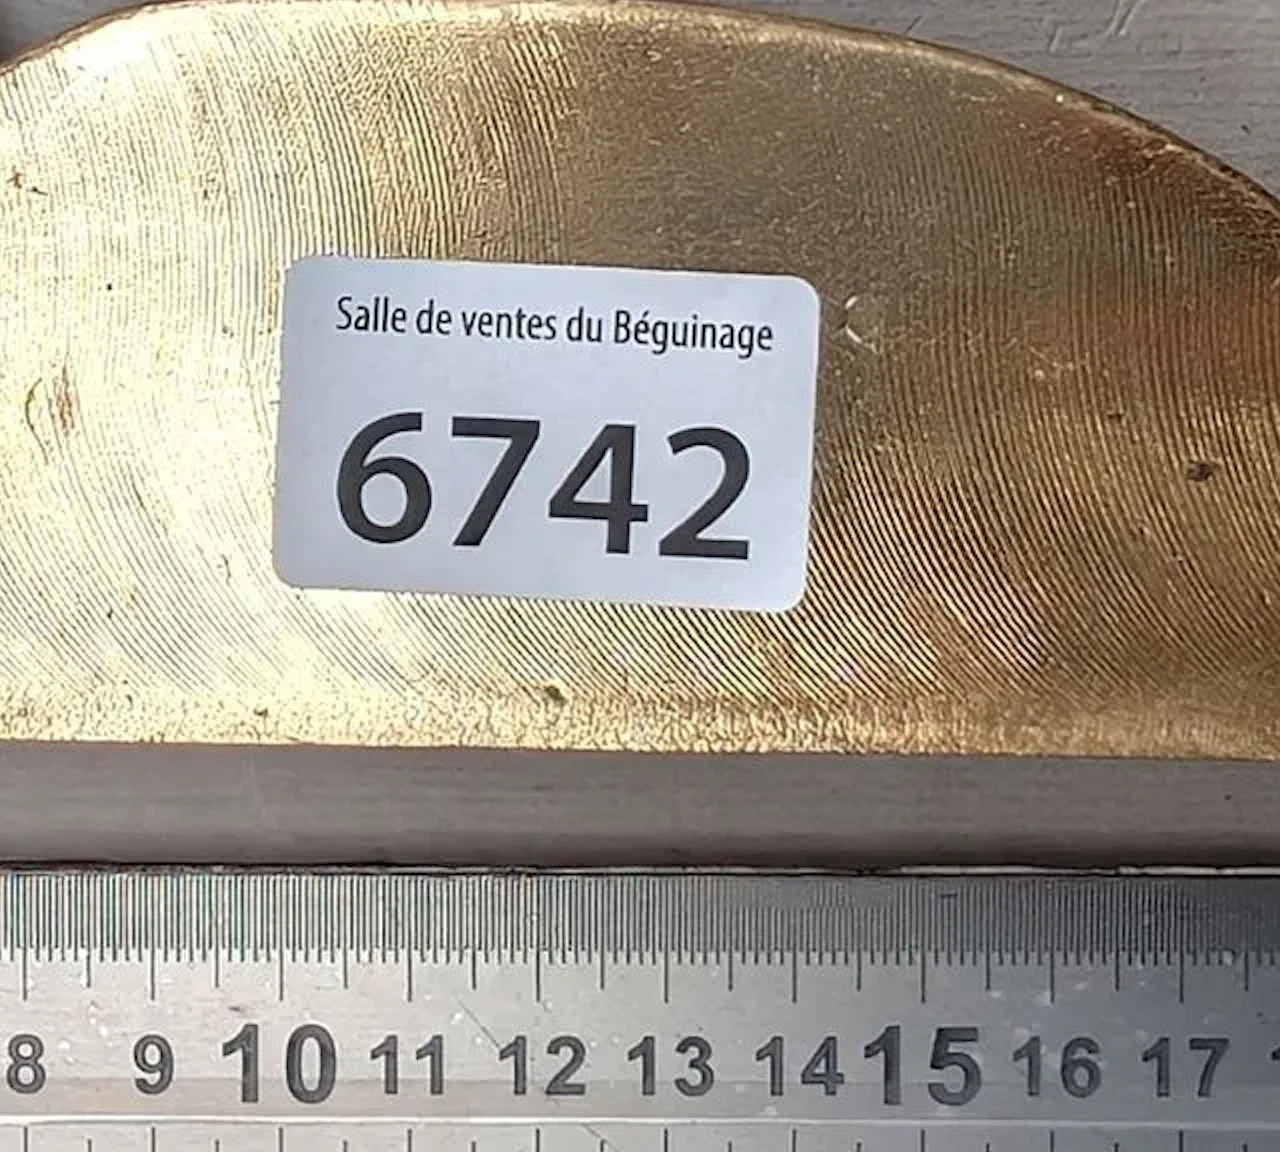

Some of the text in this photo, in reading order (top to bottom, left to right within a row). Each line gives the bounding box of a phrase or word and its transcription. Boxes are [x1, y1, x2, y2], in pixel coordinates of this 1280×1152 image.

[336, 296, 773, 359] Salle de ventes du Béguinage
[336, 411, 751, 561] 6742
[7, 1034, 46, 1094] 8
[134, 1035, 173, 1094] 9
[223, 1024, 336, 1104] 10
[371, 1035, 443, 1095] 11
[499, 1036, 585, 1096] 12
[628, 1036, 714, 1096] 13
[756, 1036, 844, 1096] 14
[865, 1026, 980, 1105] 15
[1014, 1037, 1100, 1098] 16
[1142, 1038, 1229, 1097] 17
